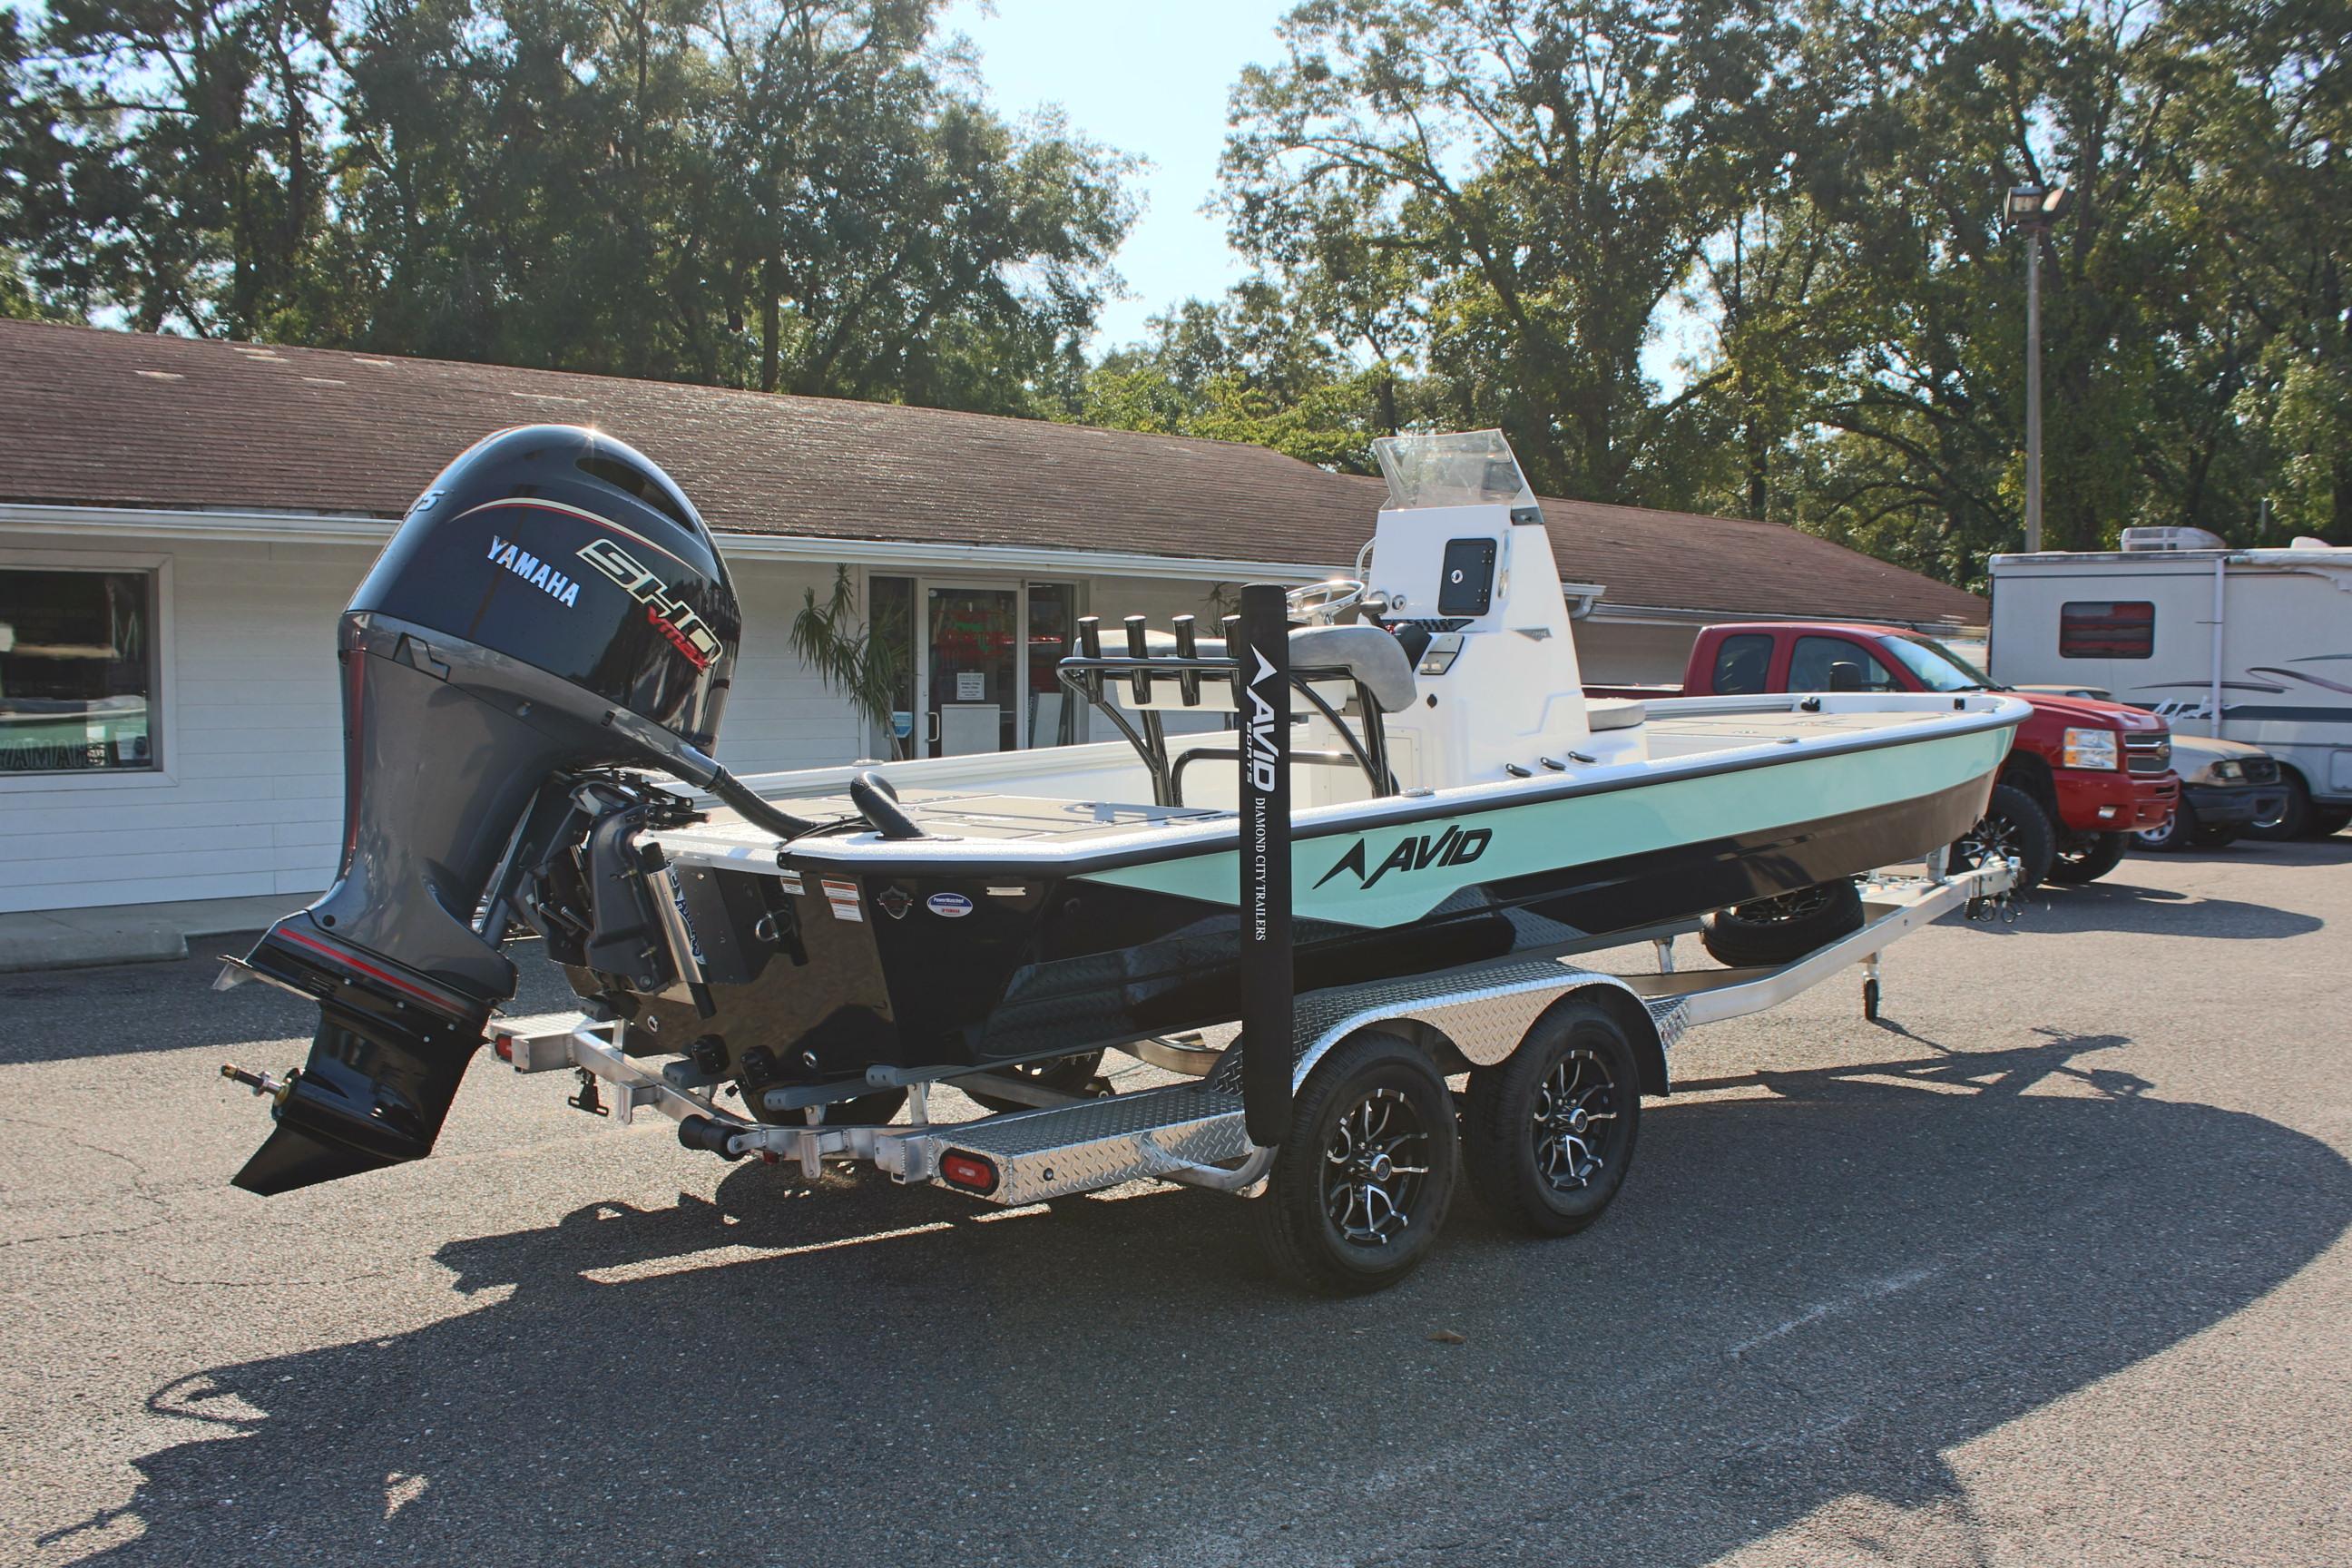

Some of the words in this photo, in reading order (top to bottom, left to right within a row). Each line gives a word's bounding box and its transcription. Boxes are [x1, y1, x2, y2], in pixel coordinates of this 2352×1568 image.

[487, 535, 581, 609] YAMAHA
[575, 538, 723, 666] SHO
[1246, 684, 1279, 793] AVID
[1255, 798, 1266, 853] DIAMOND
[1359, 824, 1494, 890] AVID
[1255, 855, 1266, 884] CITY
[1255, 884, 1266, 941] TRAILERS
